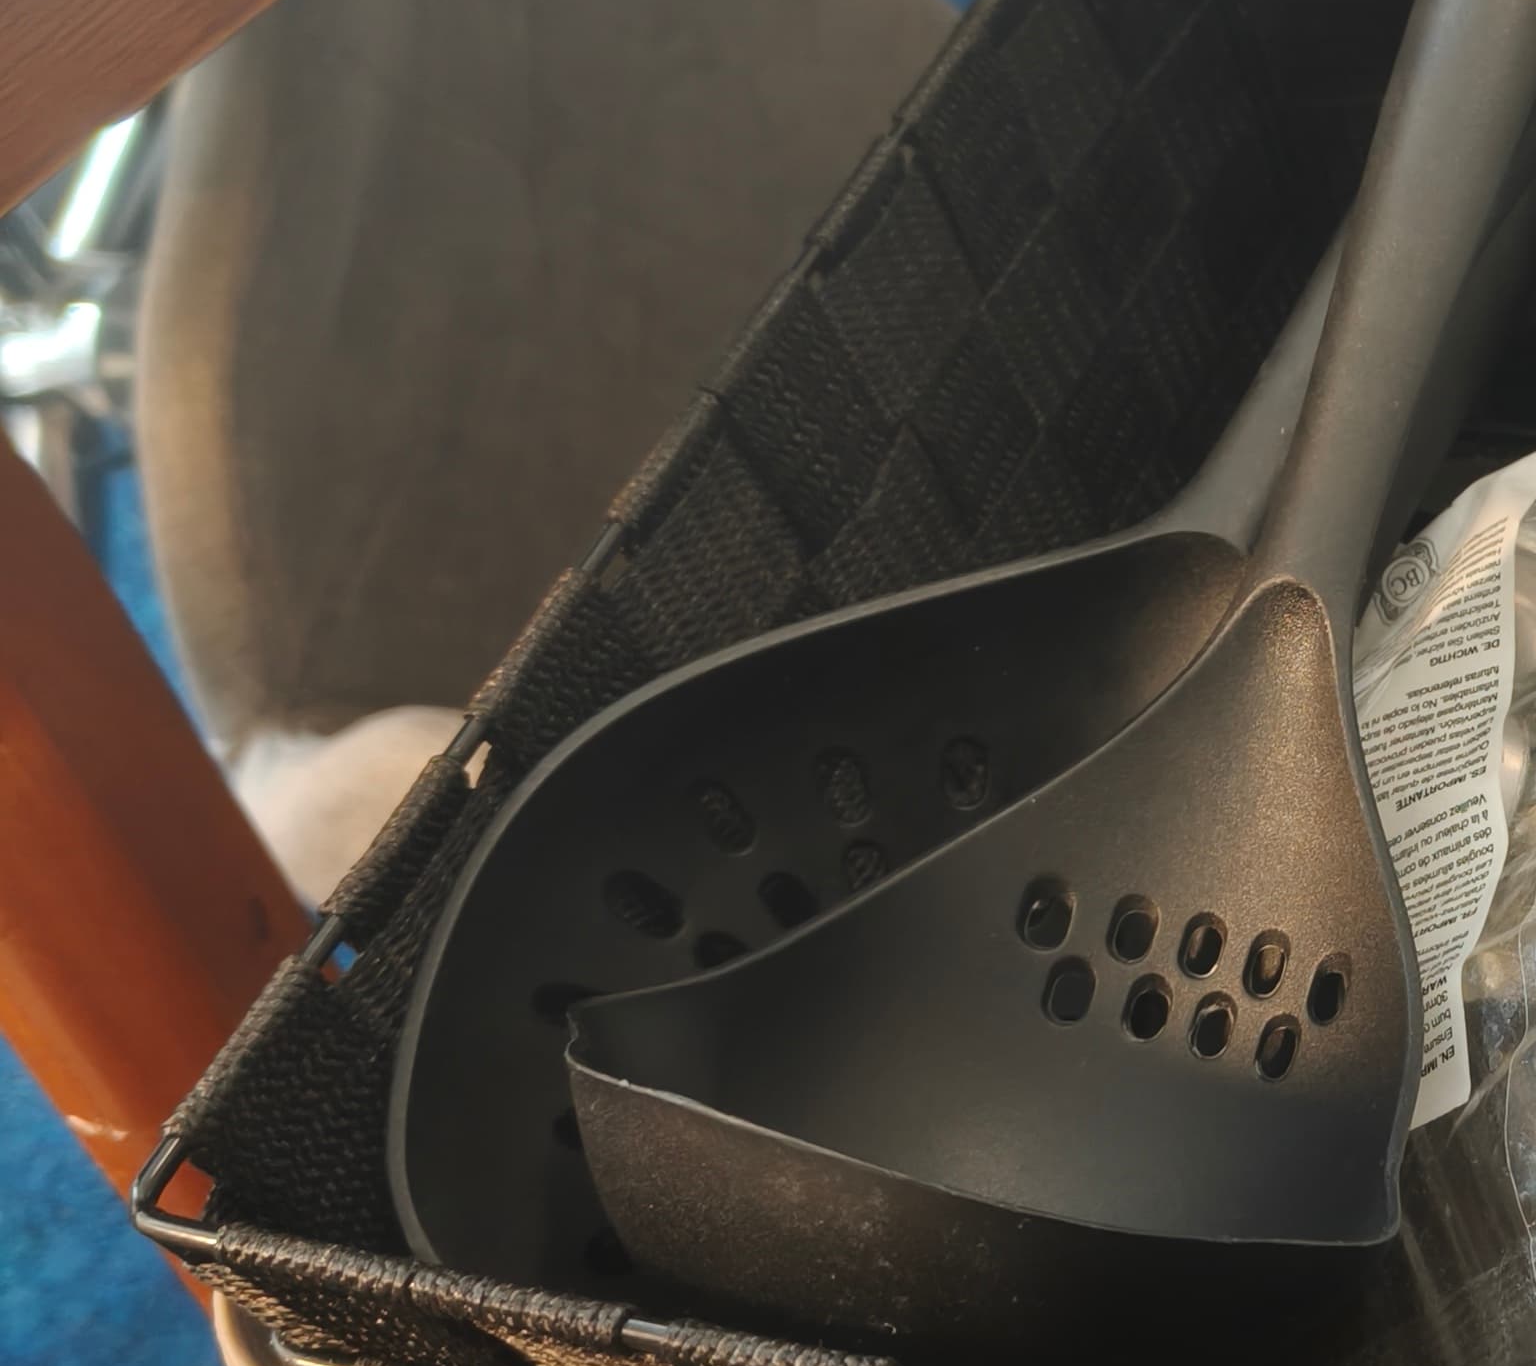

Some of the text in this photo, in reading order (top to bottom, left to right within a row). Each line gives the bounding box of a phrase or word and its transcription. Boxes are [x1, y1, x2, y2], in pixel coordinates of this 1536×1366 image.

[1390, 568, 1421, 596] BC
[1429, 645, 1479, 667] WICHTIG
[1422, 699, 1438, 710] No
[1383, 724, 1397, 735] de
[1409, 733, 1447, 753] pueden
[1382, 775, 1395, 785] un
[1397, 770, 1410, 781] en
[1395, 774, 1467, 812] IMPORTANTE
[1449, 794, 1487, 816] Veuillez
[1403, 811, 1447, 840] conserver
[1471, 813, 1480, 825] la
[1434, 819, 1469, 841] chaleur
[1473, 827, 1492, 841] des
[1432, 835, 1471, 861] animaux
[1456, 843, 1494, 867] bougies
[1418, 855, 1431, 868] de
